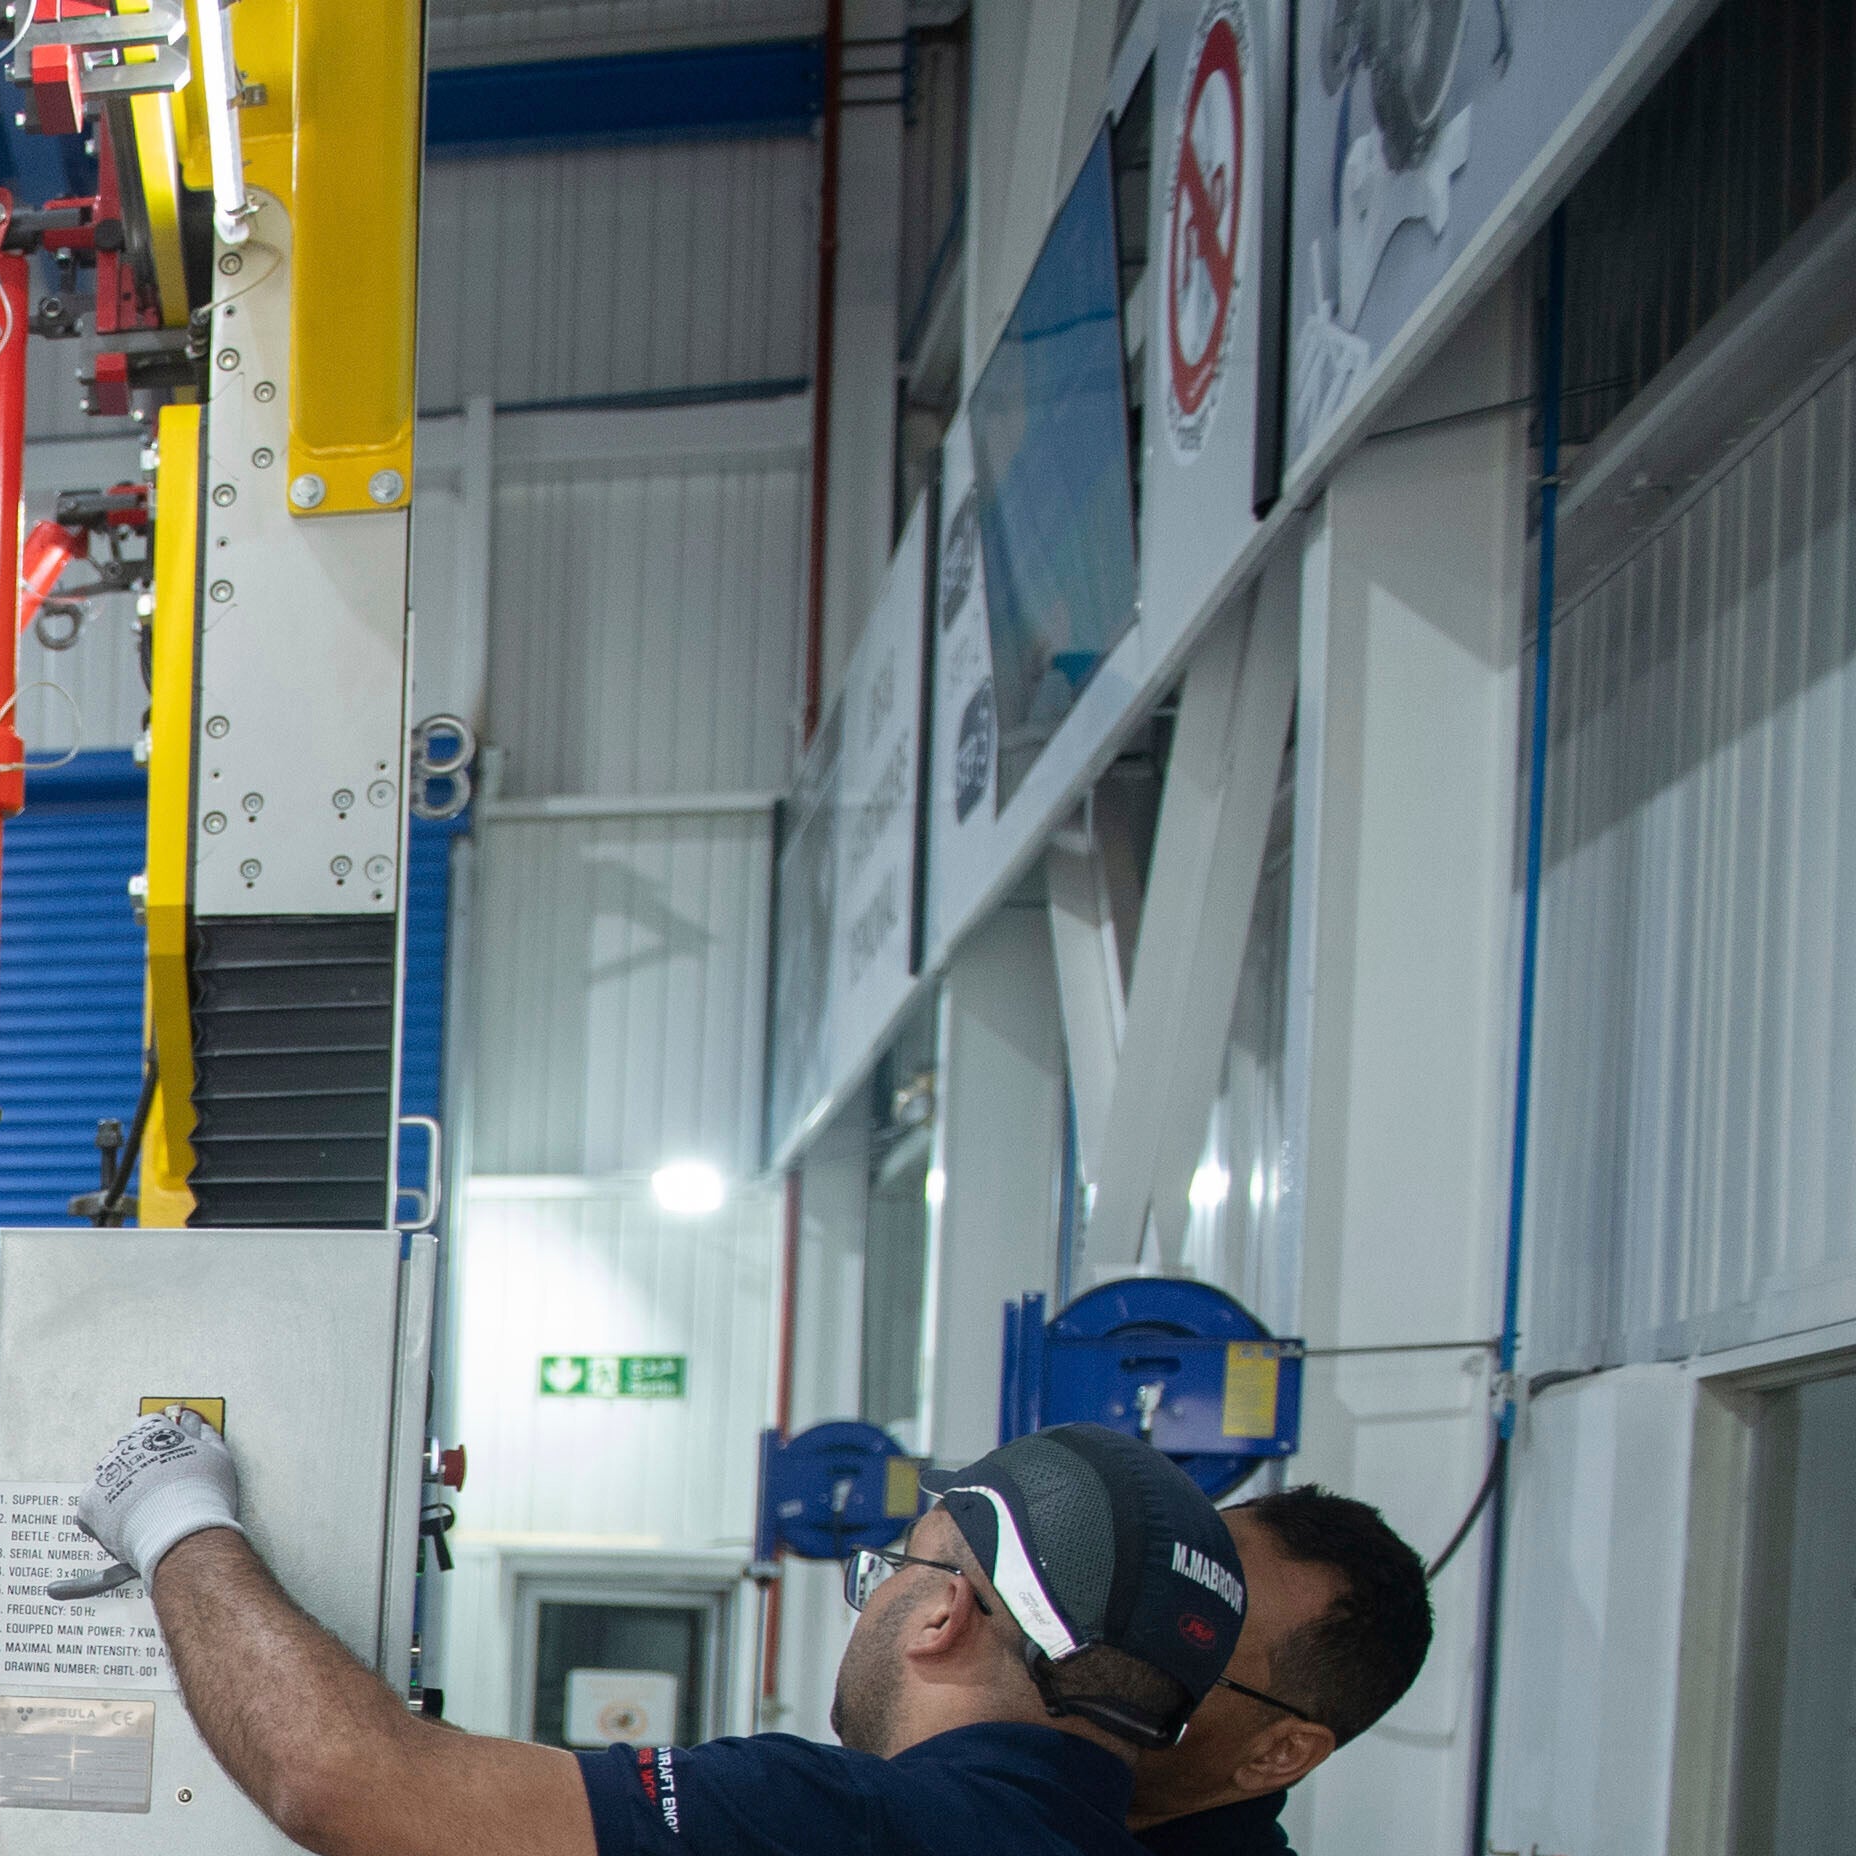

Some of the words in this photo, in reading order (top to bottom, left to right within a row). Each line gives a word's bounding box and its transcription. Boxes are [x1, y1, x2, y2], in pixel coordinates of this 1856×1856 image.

[0, 1495, 8, 1506] 1.
[12, 1494, 64, 1506] SUPPLIER:
[11, 1514, 57, 1525] MACHINE
[11, 1531, 50, 1542] BEETLE
[9, 1549, 43, 1560] SERIAL
[47, 1550, 93, 1561] NUMBER:
[9, 1566, 53, 1578] VOLTAGE:
[7, 1604, 66, 1616] FREQUENCY:
[70, 1606, 82, 1616] 50
[84, 1606, 96, 1617] Hz
[6, 1623, 53, 1635] EQUIPPED
[57, 1625, 84, 1636] MAIN
[87, 1625, 125, 1637] POWER:
[137, 1628, 156, 1638] KVA
[5, 1642, 52, 1654] MAXIMAL
[56, 1643, 83, 1655] MAIN
[86, 1645, 141, 1657] INTENSITY:
[145, 1647, 155, 1658] 10
[157, 1647, 165, 1658] A
[4, 1661, 50, 1673] DRAWING
[53, 1662, 99, 1675] NUMBER:
[39, 1707, 97, 1719] SEGULA
